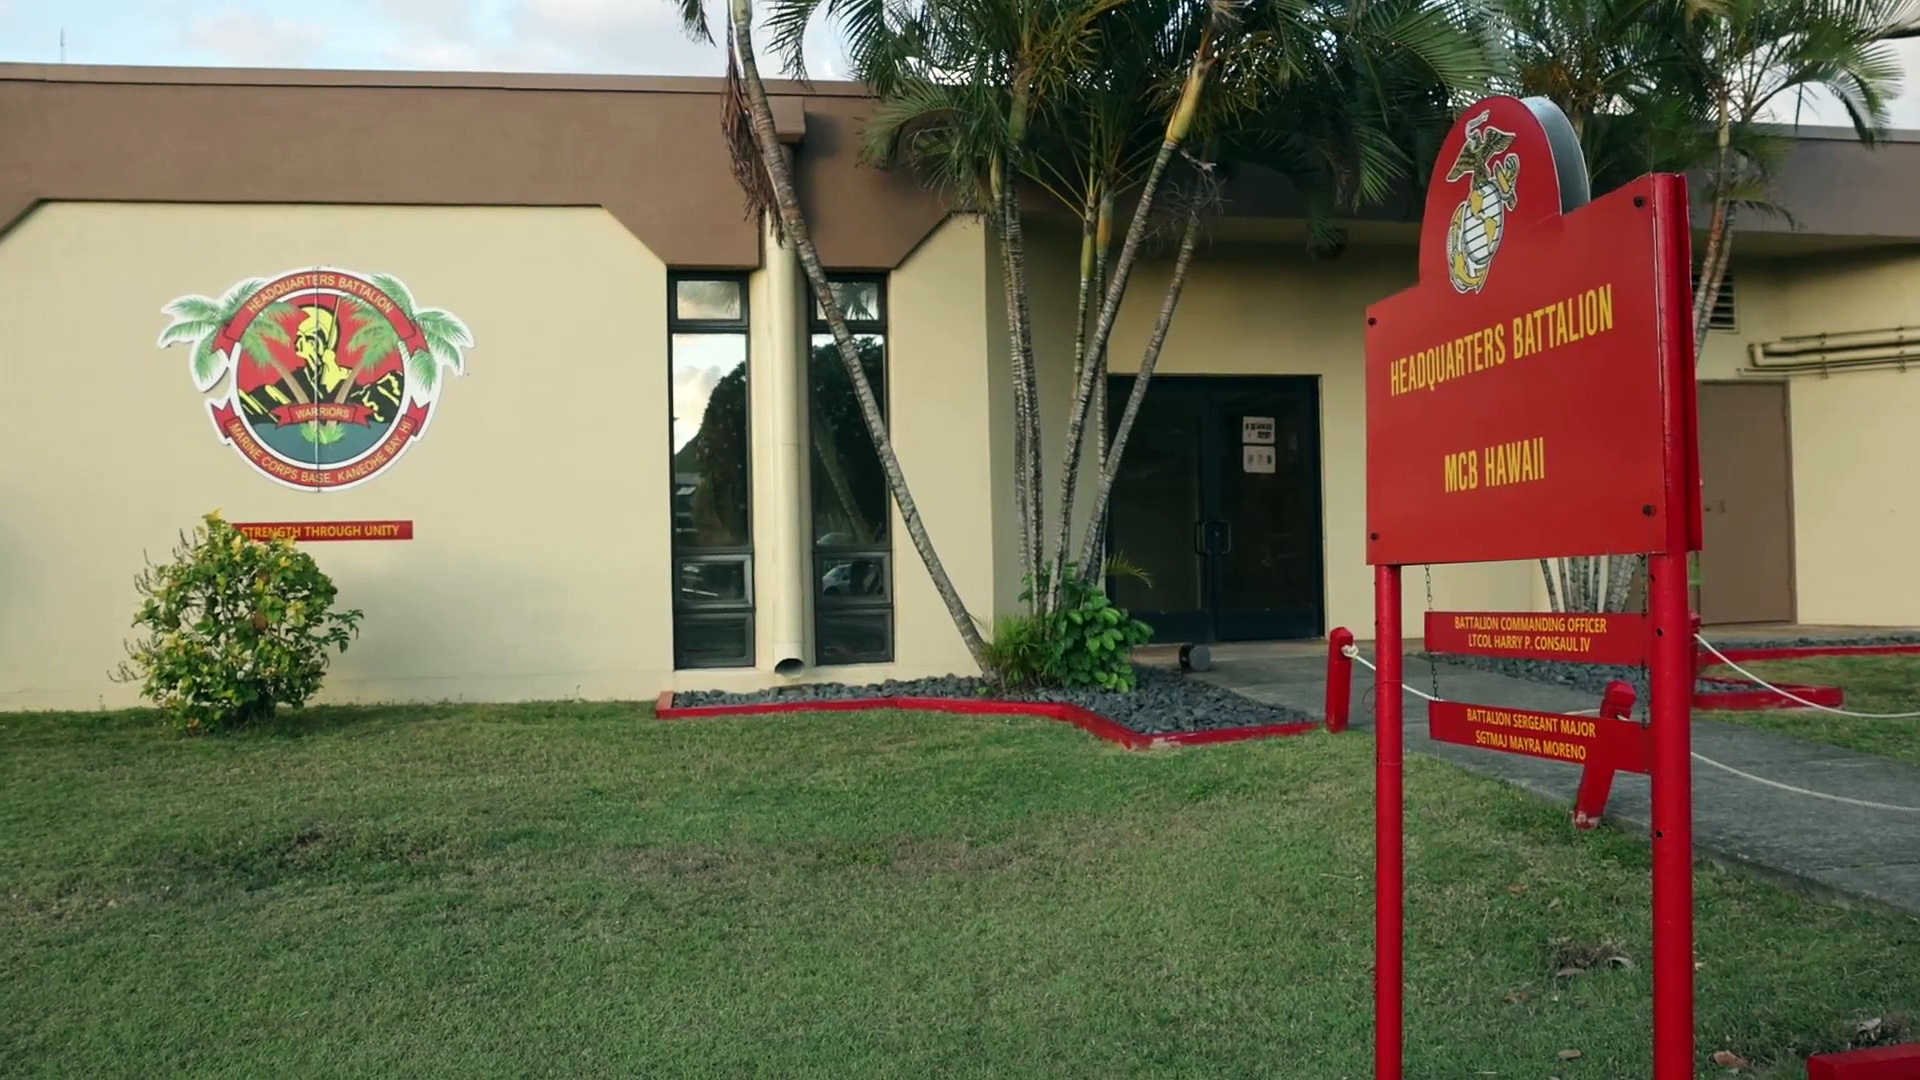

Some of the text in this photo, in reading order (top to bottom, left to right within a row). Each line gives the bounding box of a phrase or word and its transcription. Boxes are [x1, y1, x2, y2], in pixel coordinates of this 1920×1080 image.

[246, 274, 394, 313] HEADQUARTERS BATTALION
[1391, 283, 1613, 397] HEADQUARTERS BATTALION
[295, 407, 350, 419] WARRIORS
[229, 422, 260, 460] MARINE
[261, 457, 298, 481] CORPS
[337, 452, 387, 482] KANEOHE
[400, 421, 412, 433] HI
[1444, 436, 1545, 493] MCB HAWAII
[241, 524, 400, 538] STRENGTH THROUGH UNITY
[1454, 616, 1607, 633] BATTALION COMMANDING OFFICER
[1468, 634, 1591, 652] LTCOL HARRY P. CONSAUL IV
[1466, 708, 1596, 738] BATTALION SERGEANT MAJOR
[1475, 730, 1586, 760] SGTMAJ MAYRA MORENO
